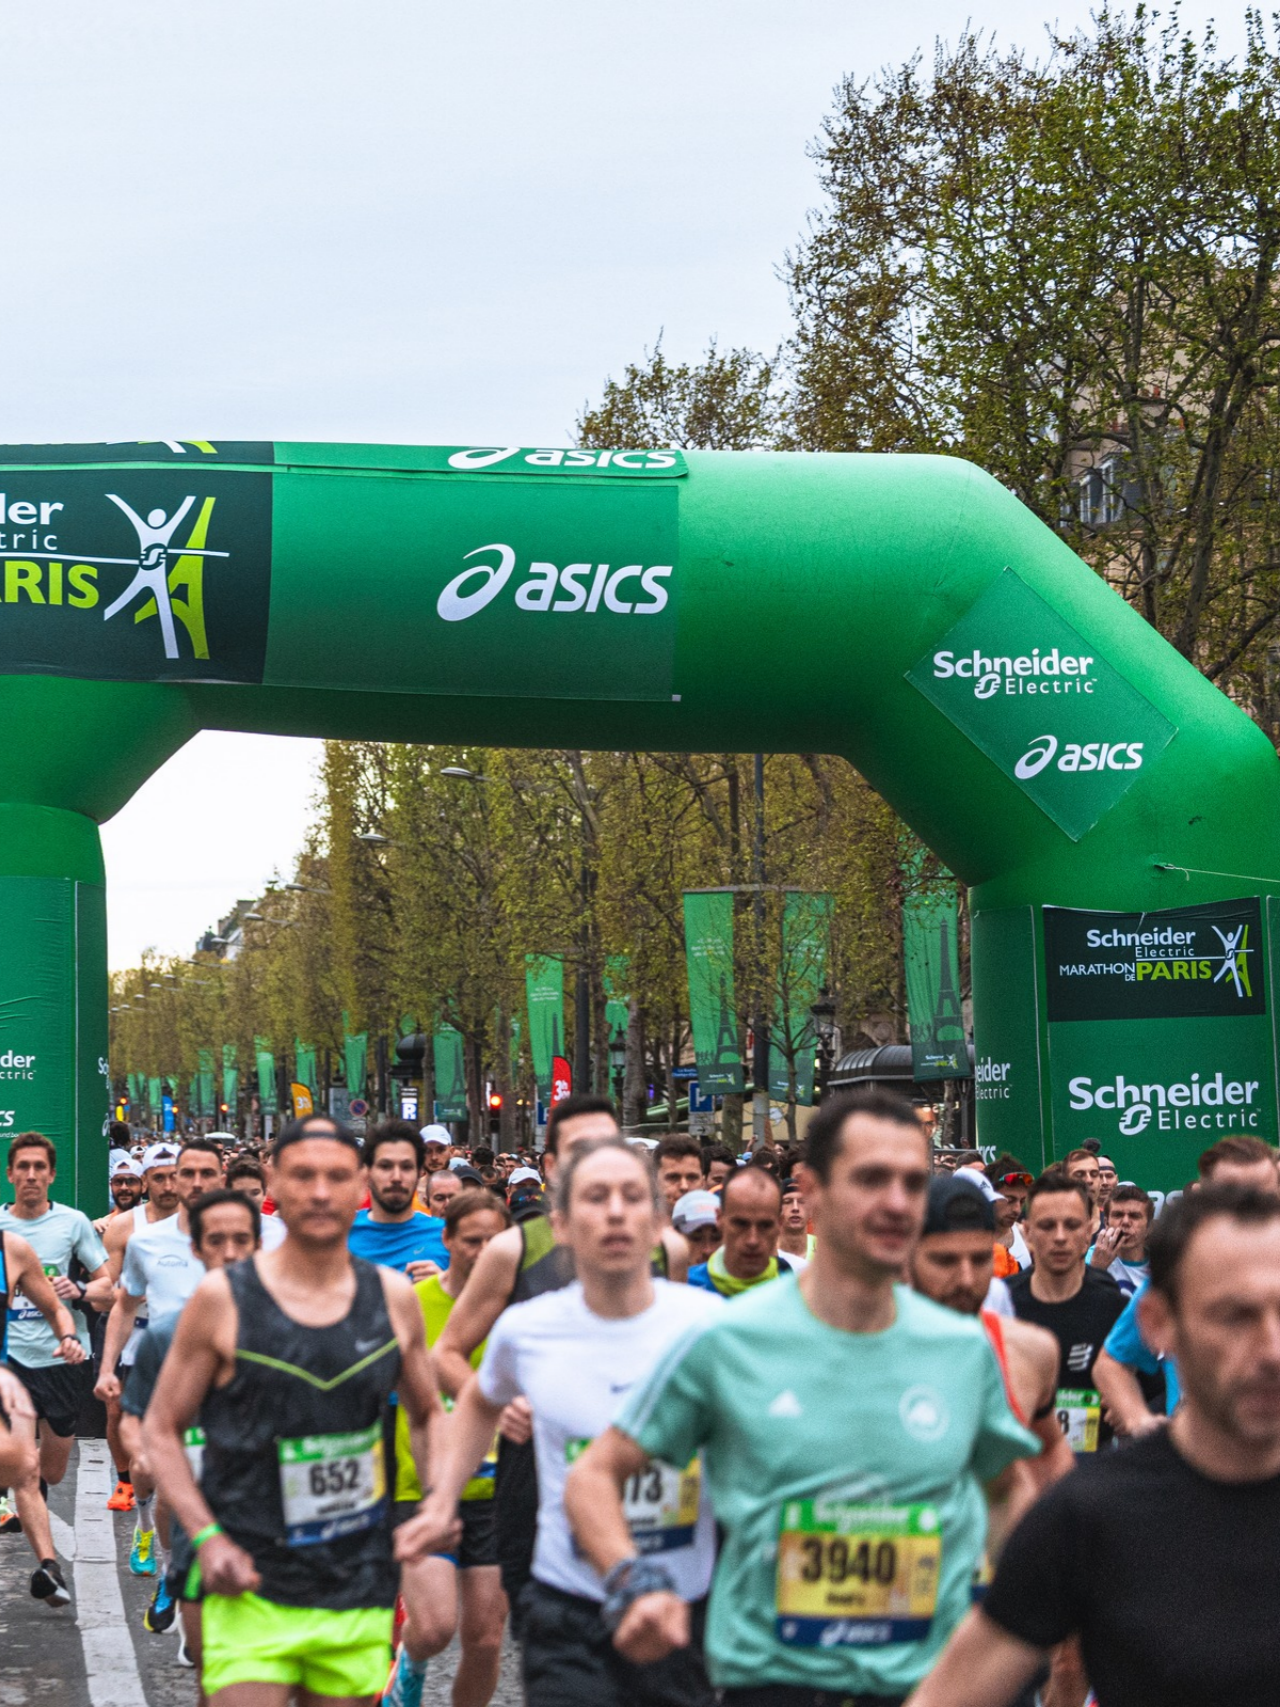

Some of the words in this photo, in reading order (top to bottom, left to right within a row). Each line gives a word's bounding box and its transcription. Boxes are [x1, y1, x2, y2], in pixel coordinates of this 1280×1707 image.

[524, 448, 677, 469] asics
[514, 561, 673, 614] asics
[933, 648, 1094, 678] Schneider
[1005, 677, 1094, 695] Electric
[1057, 742, 1144, 772] asics
[1086, 927, 1196, 948] Schneider
[1135, 945, 1194, 958] Electric
[1059, 962, 1135, 977] MARATHON
[1124, 973, 1135, 982] DE
[1136, 960, 1212, 981] PARIS
[1068, 1072, 1259, 1110] Schneider
[1158, 1109, 1258, 1130] Electric
[309, 1459, 360, 1497] 652
[802, 1537, 896, 1585] 3940
